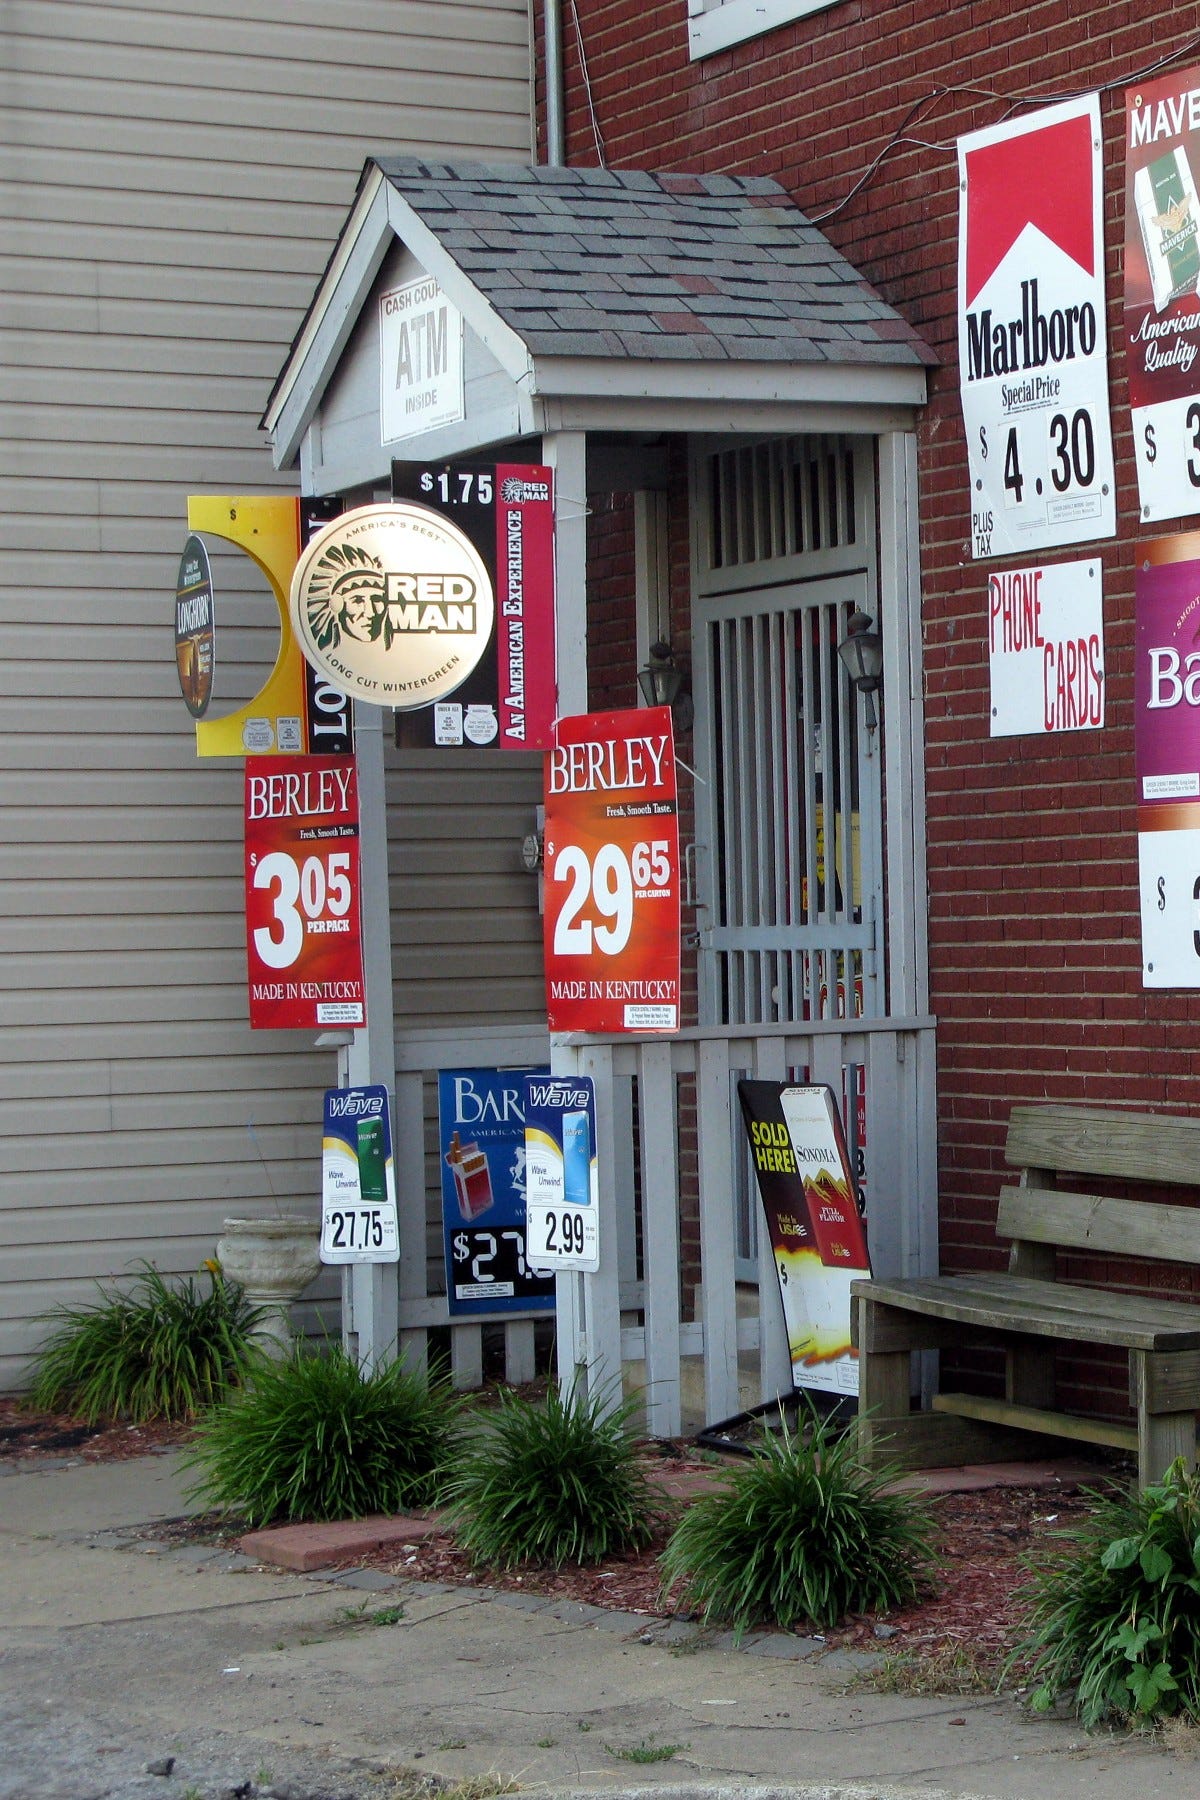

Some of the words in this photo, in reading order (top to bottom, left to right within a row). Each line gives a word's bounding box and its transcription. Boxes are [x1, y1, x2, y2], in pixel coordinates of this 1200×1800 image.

[1160, 222, 1197, 254] MAVERICK
[386, 290, 412, 316] CASH
[966, 278, 1096, 381] Marlboro
[396, 306, 448, 391] ATM
[1144, 337, 1199, 372] Quality
[405, 388, 438, 415] INSIDE
[1002, 378, 1036, 407] Special
[1036, 375, 1061, 398] Price
[523, 482, 549, 491] RED
[523, 491, 549, 501] MAN
[345, 521, 407, 540] AMERICA'S
[412, 524, 441, 543] BEST
[973, 511, 994, 533] PLUS
[975, 534, 992, 556] TAX
[503, 510, 523, 617] EXPERIENCE
[385, 573, 476, 602] RED
[177, 594, 210, 635] LONGHORN
[387, 602, 476, 633] MAN
[989, 570, 1045, 654] PHONE
[325, 653, 353, 679] LONG
[356, 676, 379, 690] CUT
[383, 655, 461, 692] WINTERGREEN
[504, 621, 524, 709] AMERICAN
[1043, 634, 1102, 732] CARDS
[505, 713, 526, 741] AN
[547, 735, 669, 794] BERLEY
[248, 767, 353, 820] BERLEY
[606, 804, 626, 817] Fresh,
[627, 804, 652, 816] Smooth
[652, 802, 672, 815] Taste.
[300, 828, 317, 840] Fresh,
[317, 827, 338, 838] Smooth
[338, 825, 355, 837] Taste.
[634, 889, 647, 898] PER
[647, 888, 671, 898] CARTON
[307, 920, 326, 934] PER
[326, 919, 350, 932] PACK
[252, 983, 285, 1001] MADE
[286, 982, 299, 999] IN
[300, 980, 361, 1000] KENTUCKY!
[550, 981, 588, 1000] MADE
[589, 980, 603, 999] IN
[605, 979, 676, 1000] KENTUCKY!
[329, 1095, 383, 1117] Wave
[453, 1077, 525, 1124] BAR
[529, 1084, 589, 1109] Wave
[751, 1121, 789, 1148] SOLD
[756, 1148, 796, 1175] HERE!
[796, 1145, 837, 1163] SONOMA
[819, 1214, 845, 1223] FLAVOR
[821, 1206, 839, 1215] FULL
[546, 1211, 584, 1255] 2.99
